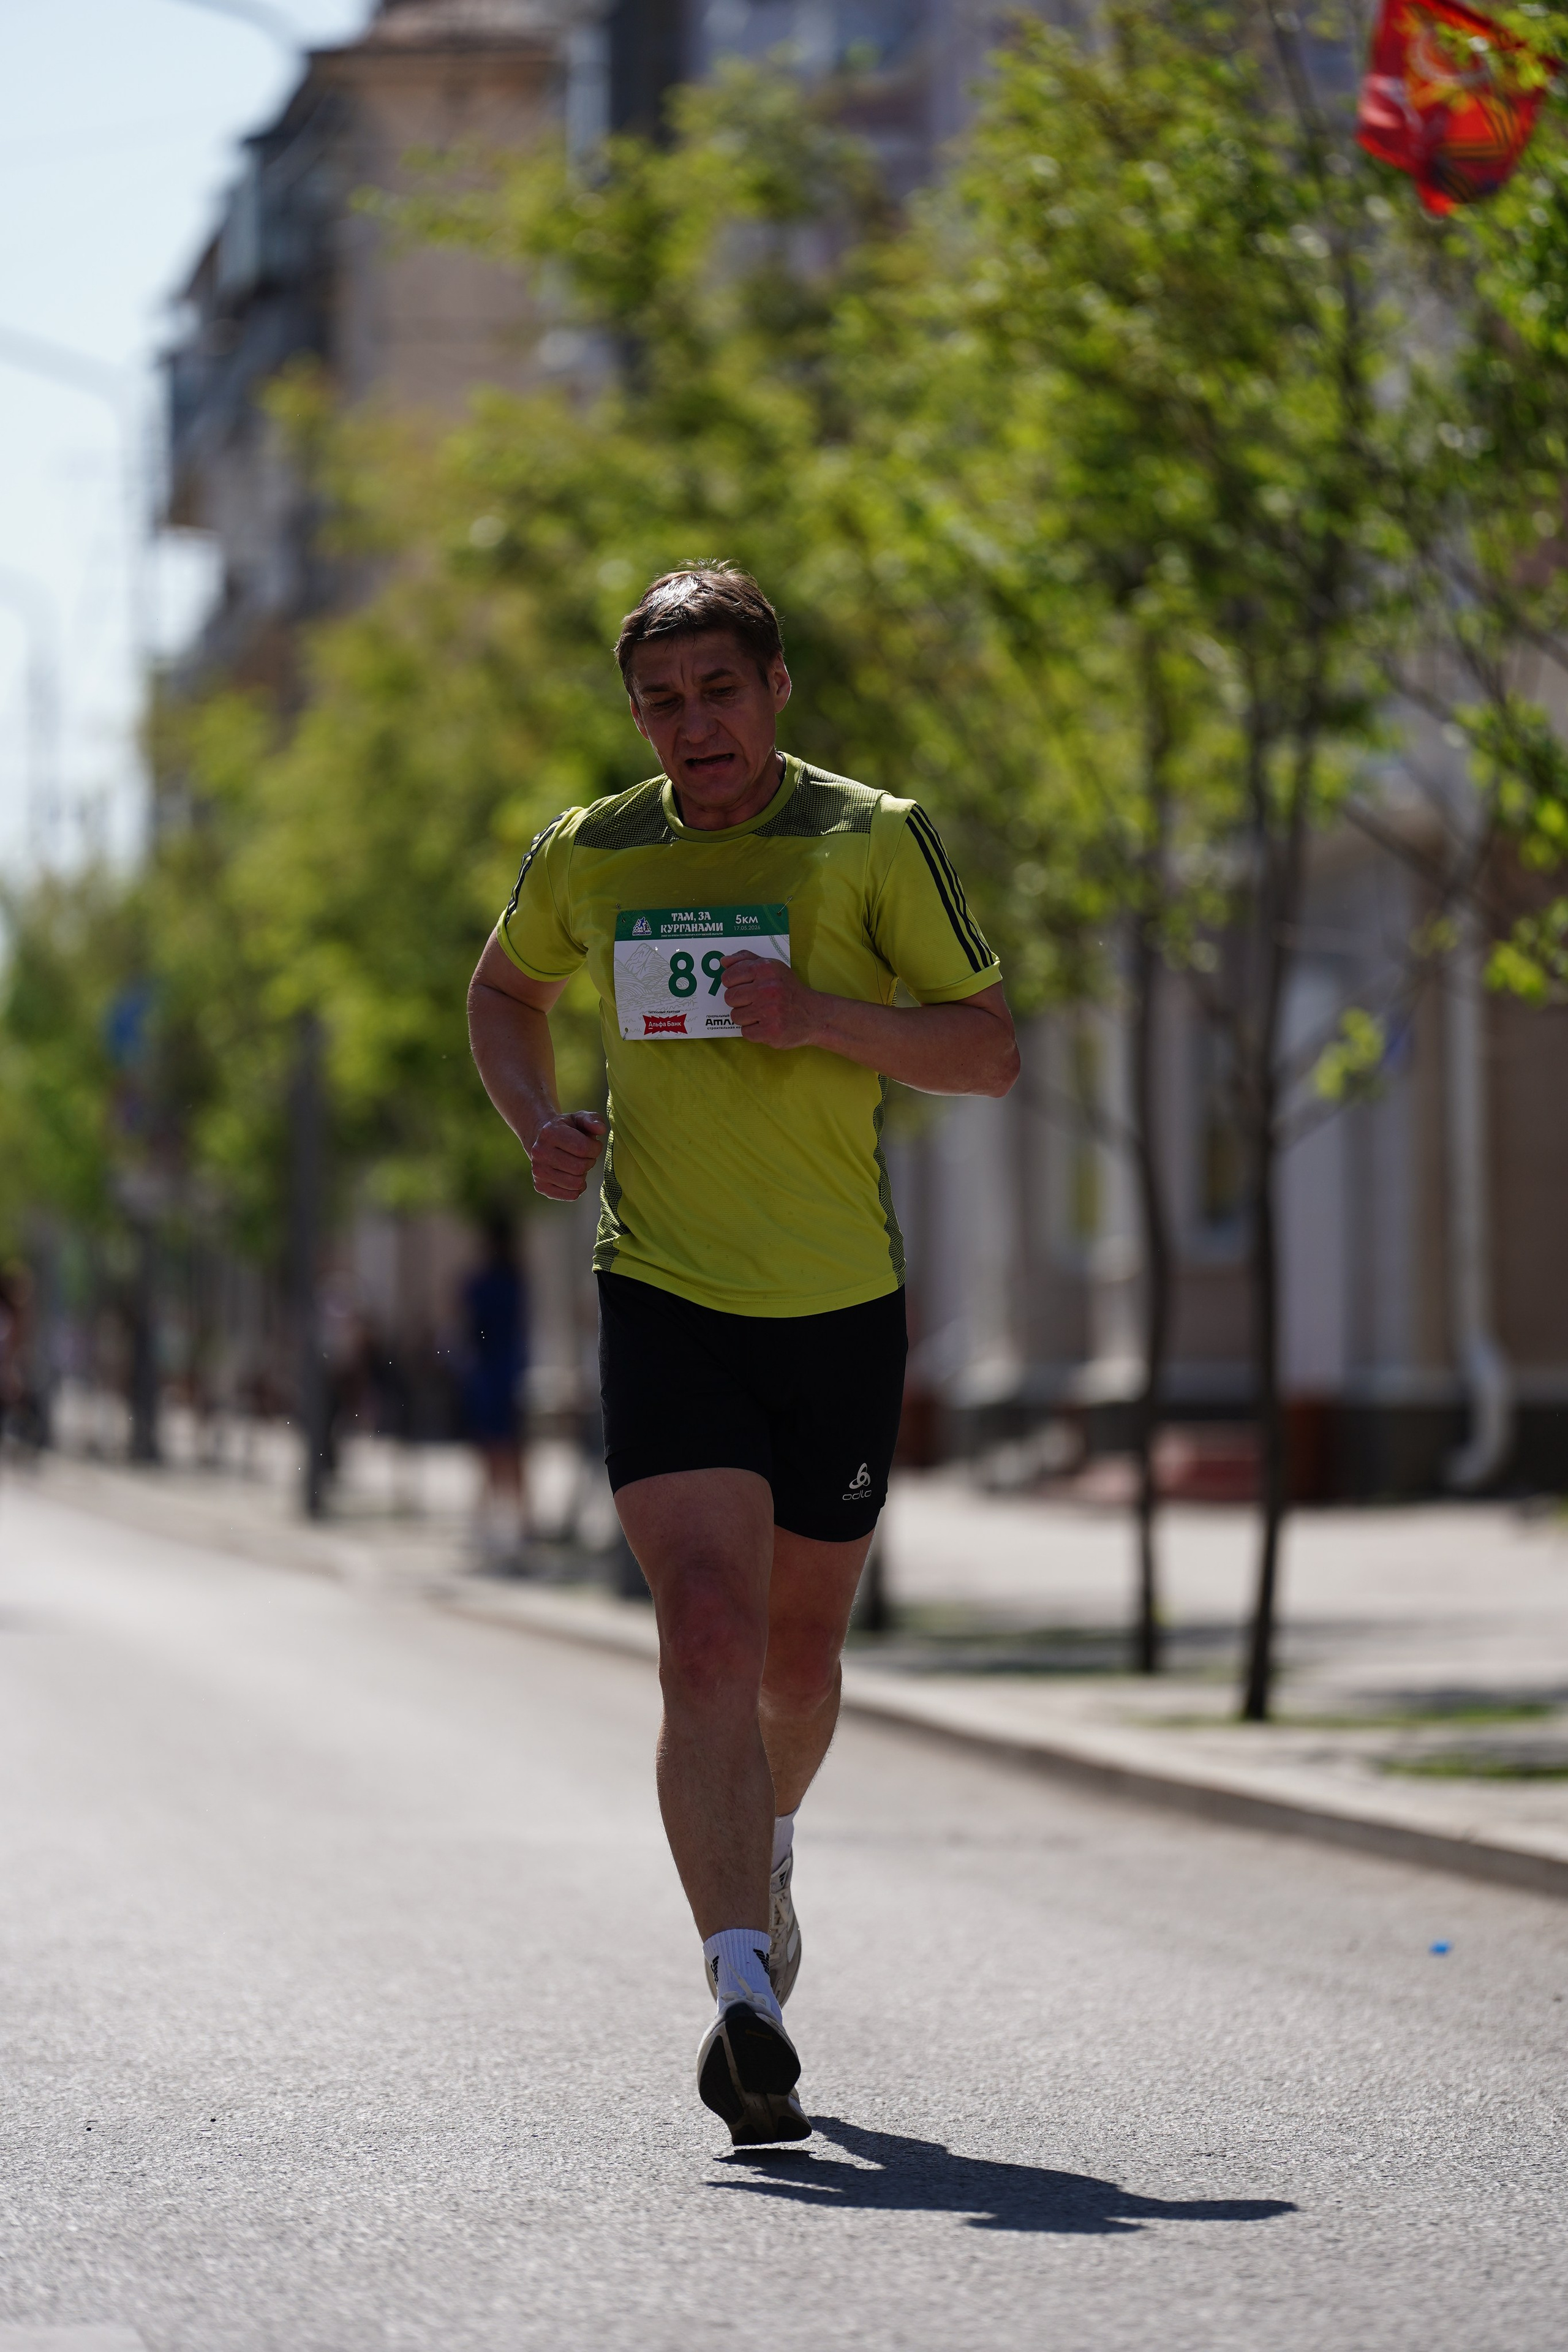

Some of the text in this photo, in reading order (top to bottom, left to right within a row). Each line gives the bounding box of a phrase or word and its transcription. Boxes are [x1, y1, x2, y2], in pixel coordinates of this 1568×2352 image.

[671, 911, 711, 922] ТАМ, ЗА
[660, 922, 723, 933] КУРГАНАМИ
[668, 951, 727, 998] 89
[842, 1490, 872, 1501] odlo
